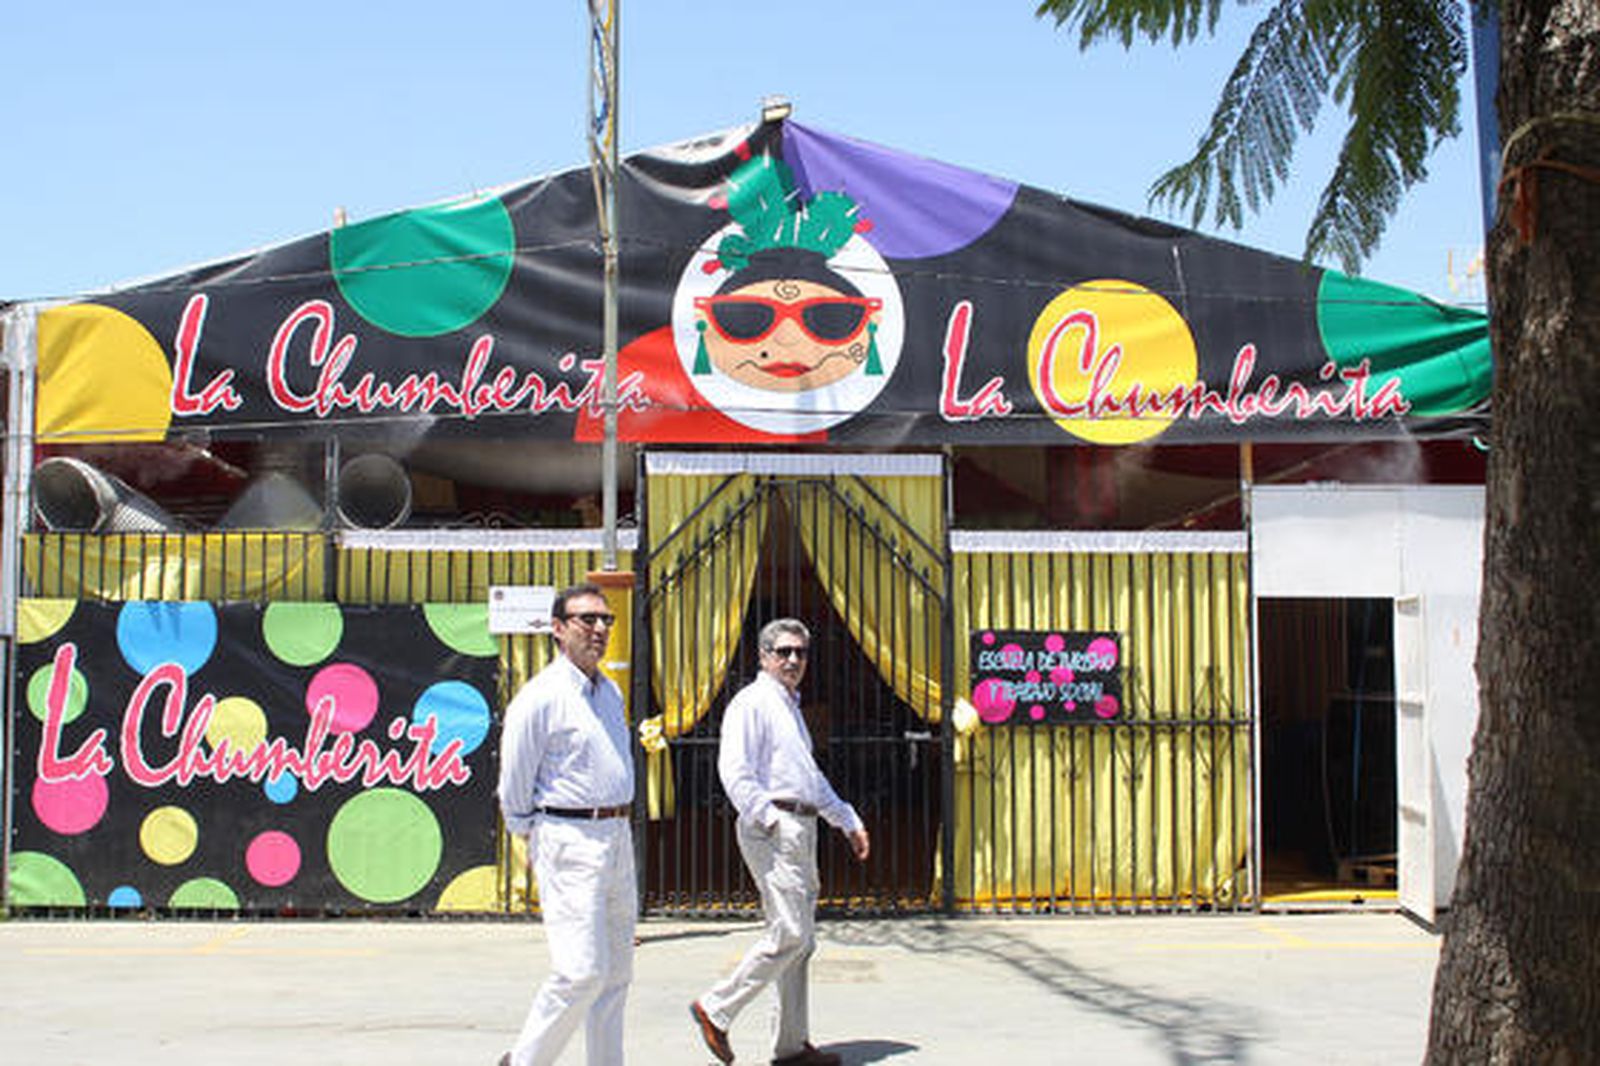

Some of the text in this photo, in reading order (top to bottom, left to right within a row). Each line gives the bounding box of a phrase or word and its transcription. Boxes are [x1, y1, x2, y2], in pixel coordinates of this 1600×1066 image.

[170, 293, 652, 419] La Chumberita
[940, 299, 1412, 424] La Chumberita
[36, 641, 471, 793] La Chumberita
